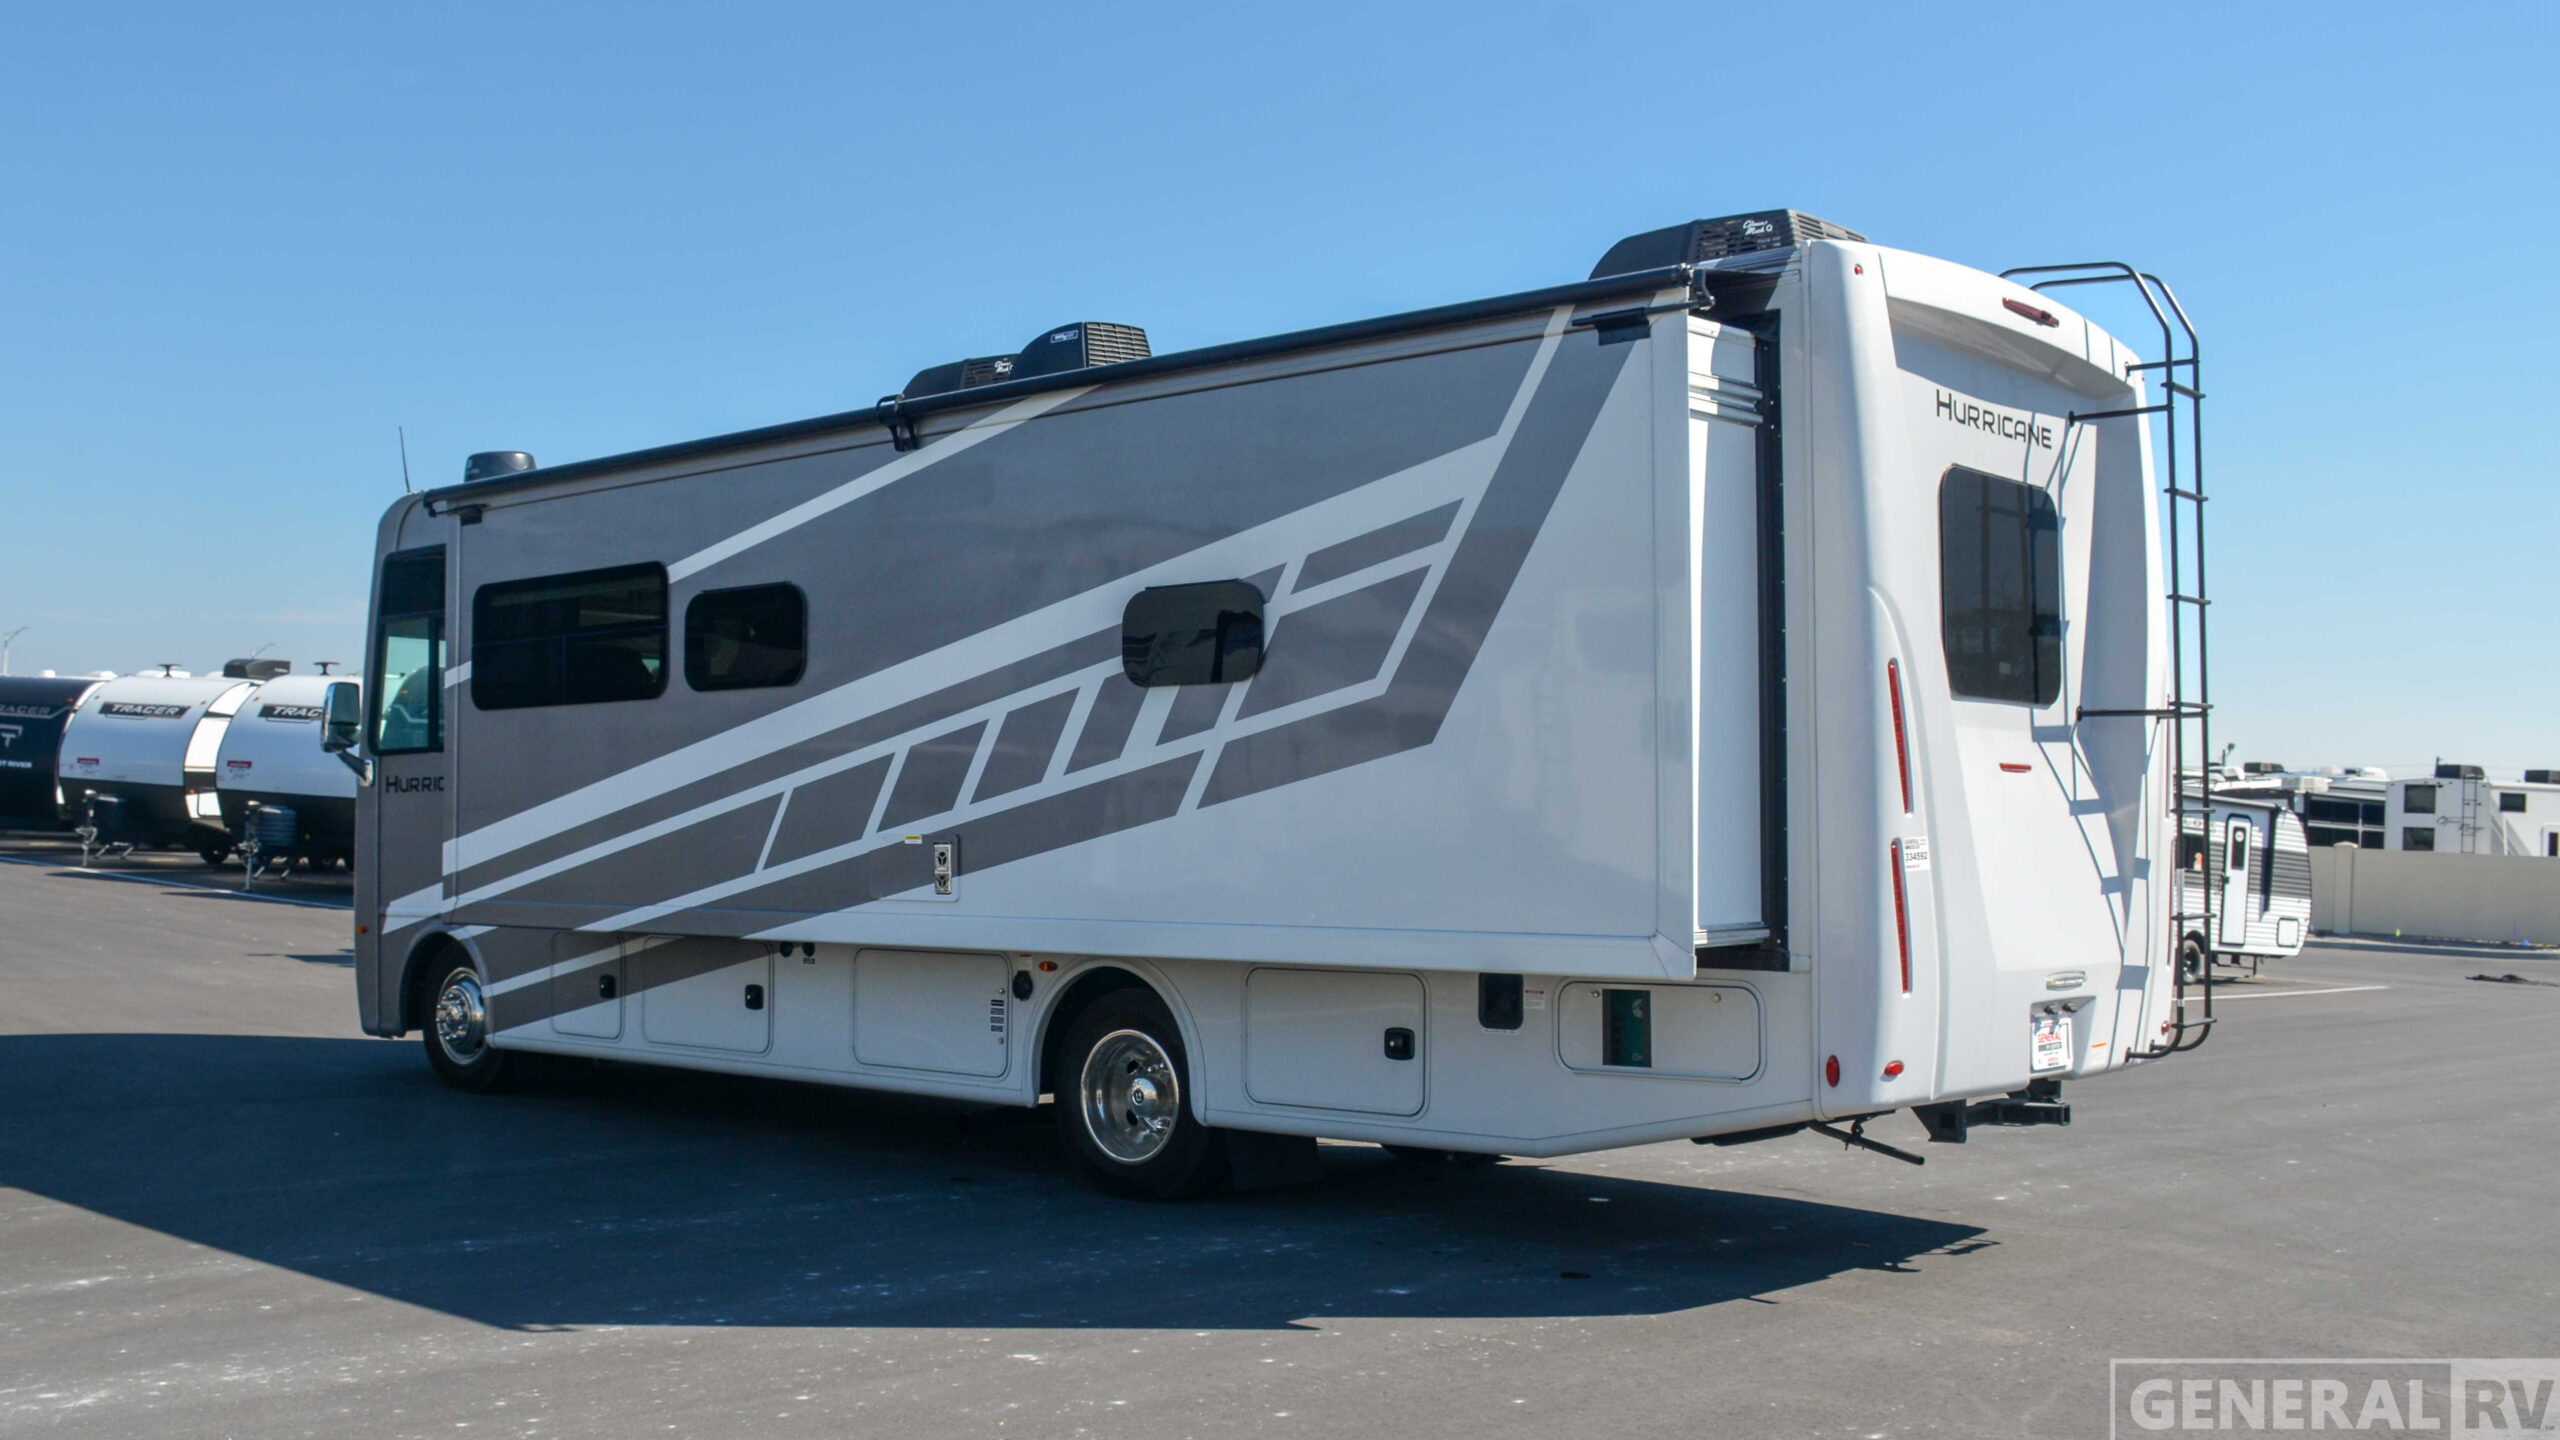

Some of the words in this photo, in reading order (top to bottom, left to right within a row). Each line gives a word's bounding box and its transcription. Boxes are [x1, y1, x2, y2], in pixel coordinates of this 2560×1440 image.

[1936, 388, 2052, 450] HURRICANE
[111, 703, 180, 715] TRACER
[385, 775, 445, 793] HURRIC
